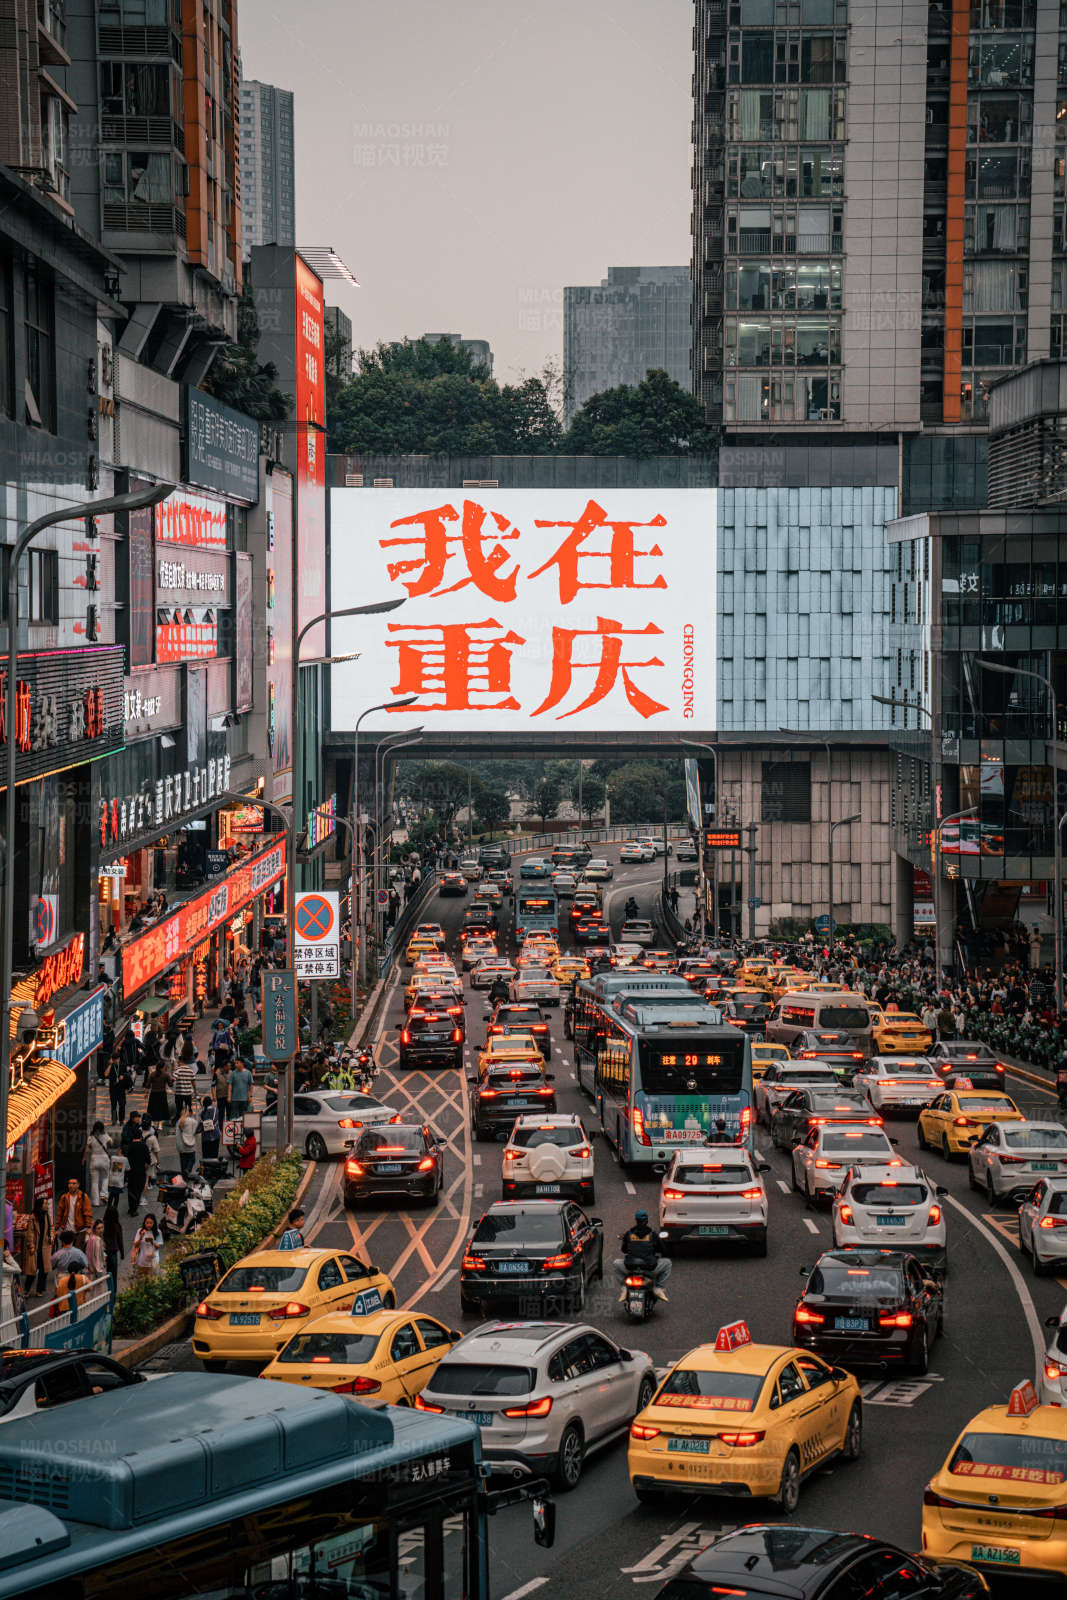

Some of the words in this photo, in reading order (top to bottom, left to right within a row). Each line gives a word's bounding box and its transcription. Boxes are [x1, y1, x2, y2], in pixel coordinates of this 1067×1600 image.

[379, 499, 668, 605] 我在
[383, 615, 670, 720] 重庆
[682, 623, 694, 718] CHONGQING
[271, 976, 283, 992] P
